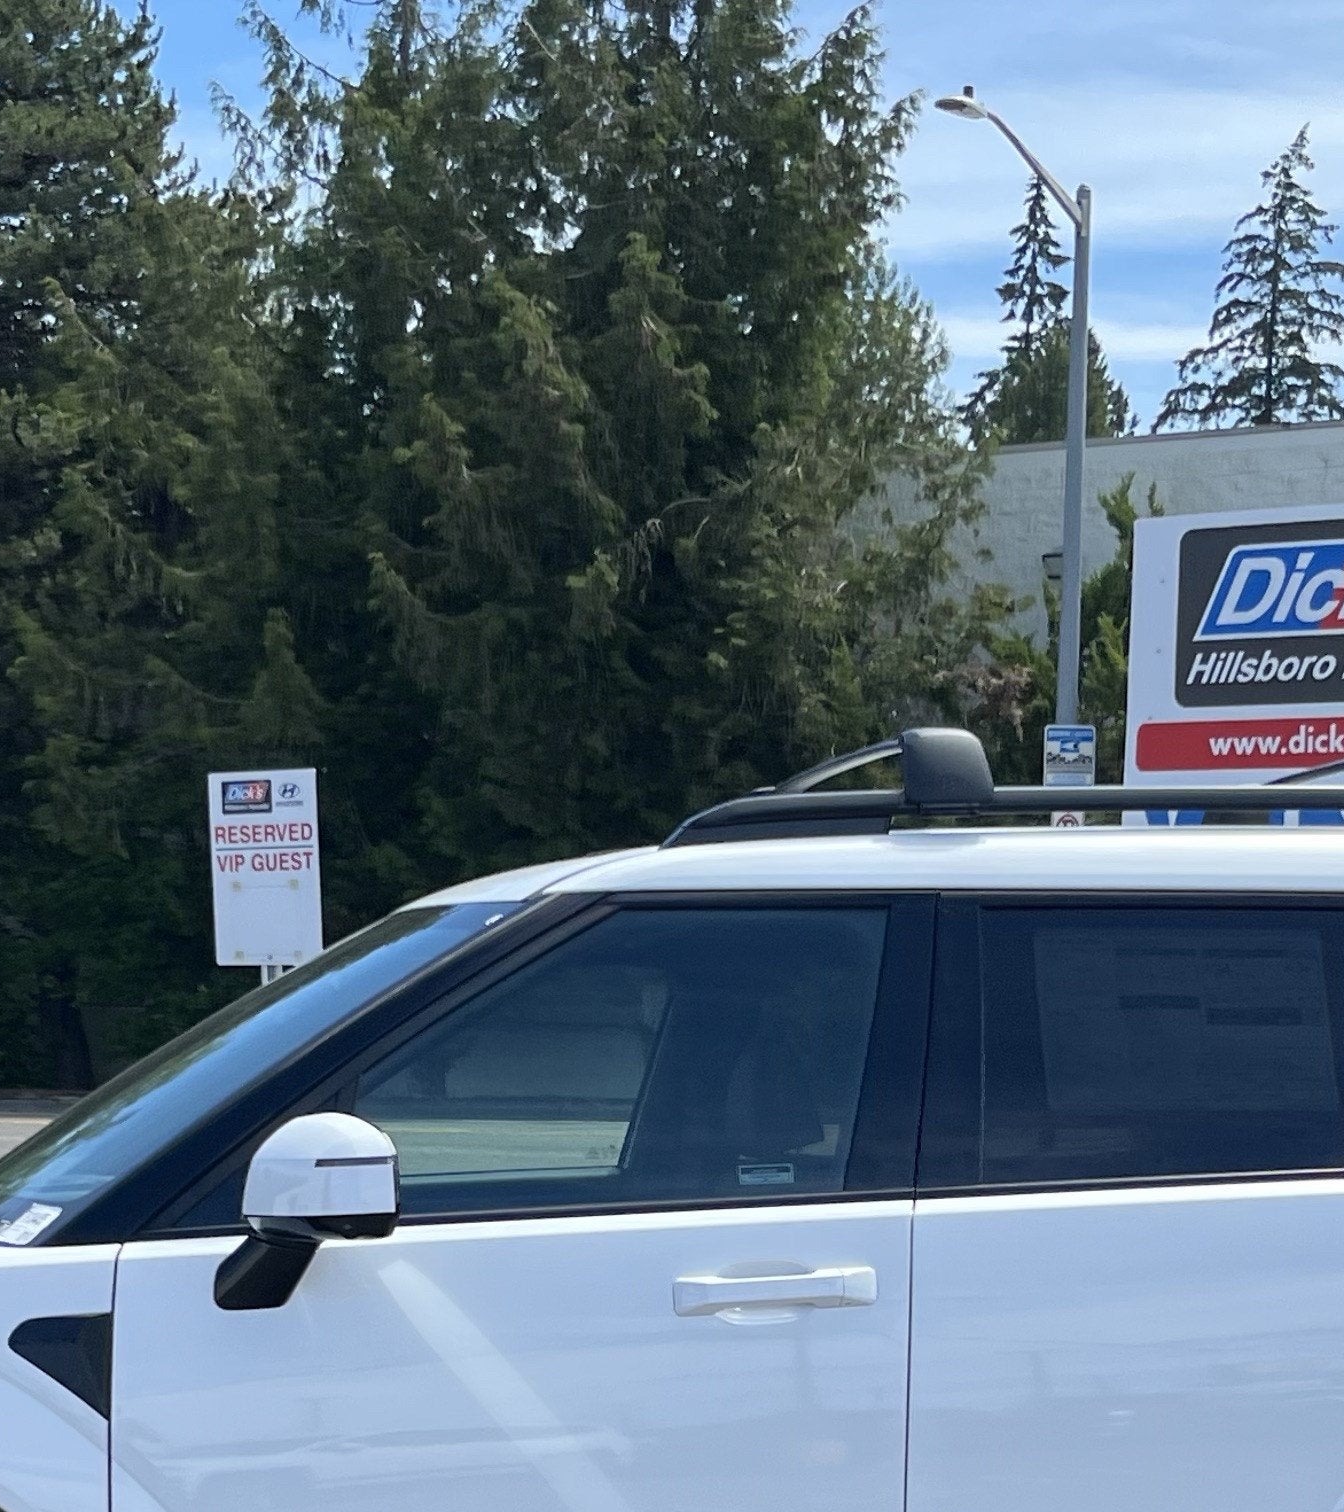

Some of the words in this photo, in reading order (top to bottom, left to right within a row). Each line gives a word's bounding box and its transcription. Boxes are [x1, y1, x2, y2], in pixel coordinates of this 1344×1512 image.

[1186, 650, 1337, 686] Hillsboro
[214, 823, 314, 845] RESERVED
[217, 853, 246, 873] VIP
[251, 852, 314, 872] GUEST
